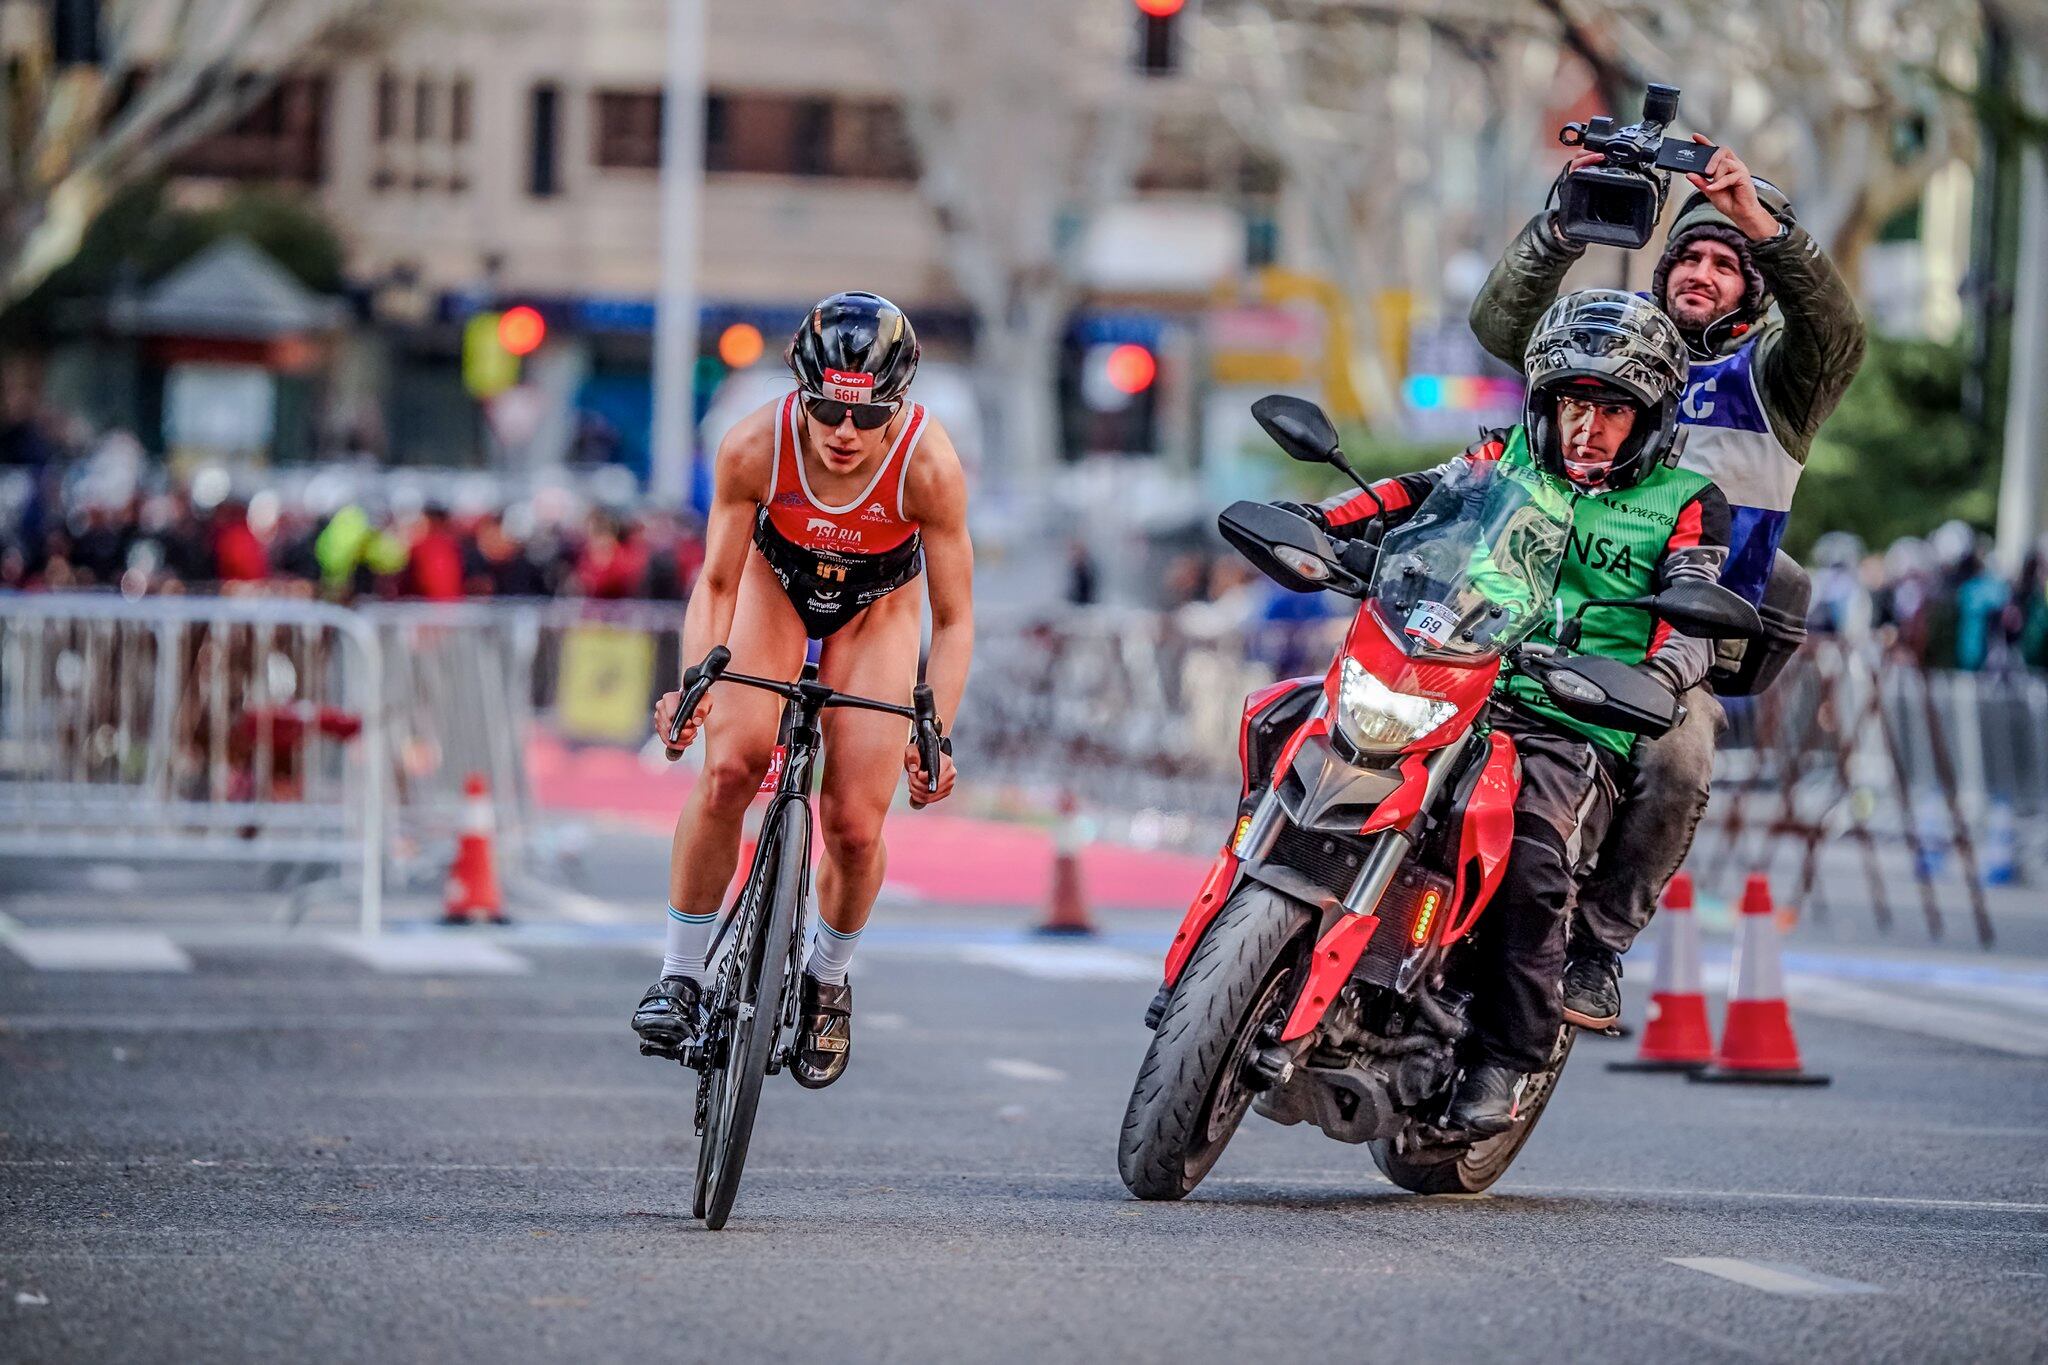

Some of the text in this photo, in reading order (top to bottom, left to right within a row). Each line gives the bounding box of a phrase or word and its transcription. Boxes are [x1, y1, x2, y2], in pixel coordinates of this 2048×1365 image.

[1678, 149, 1696, 158] 4K
[834, 389, 860, 402] 56H
[1563, 525, 1632, 578] NSA
[1419, 616, 1442, 634] 69
